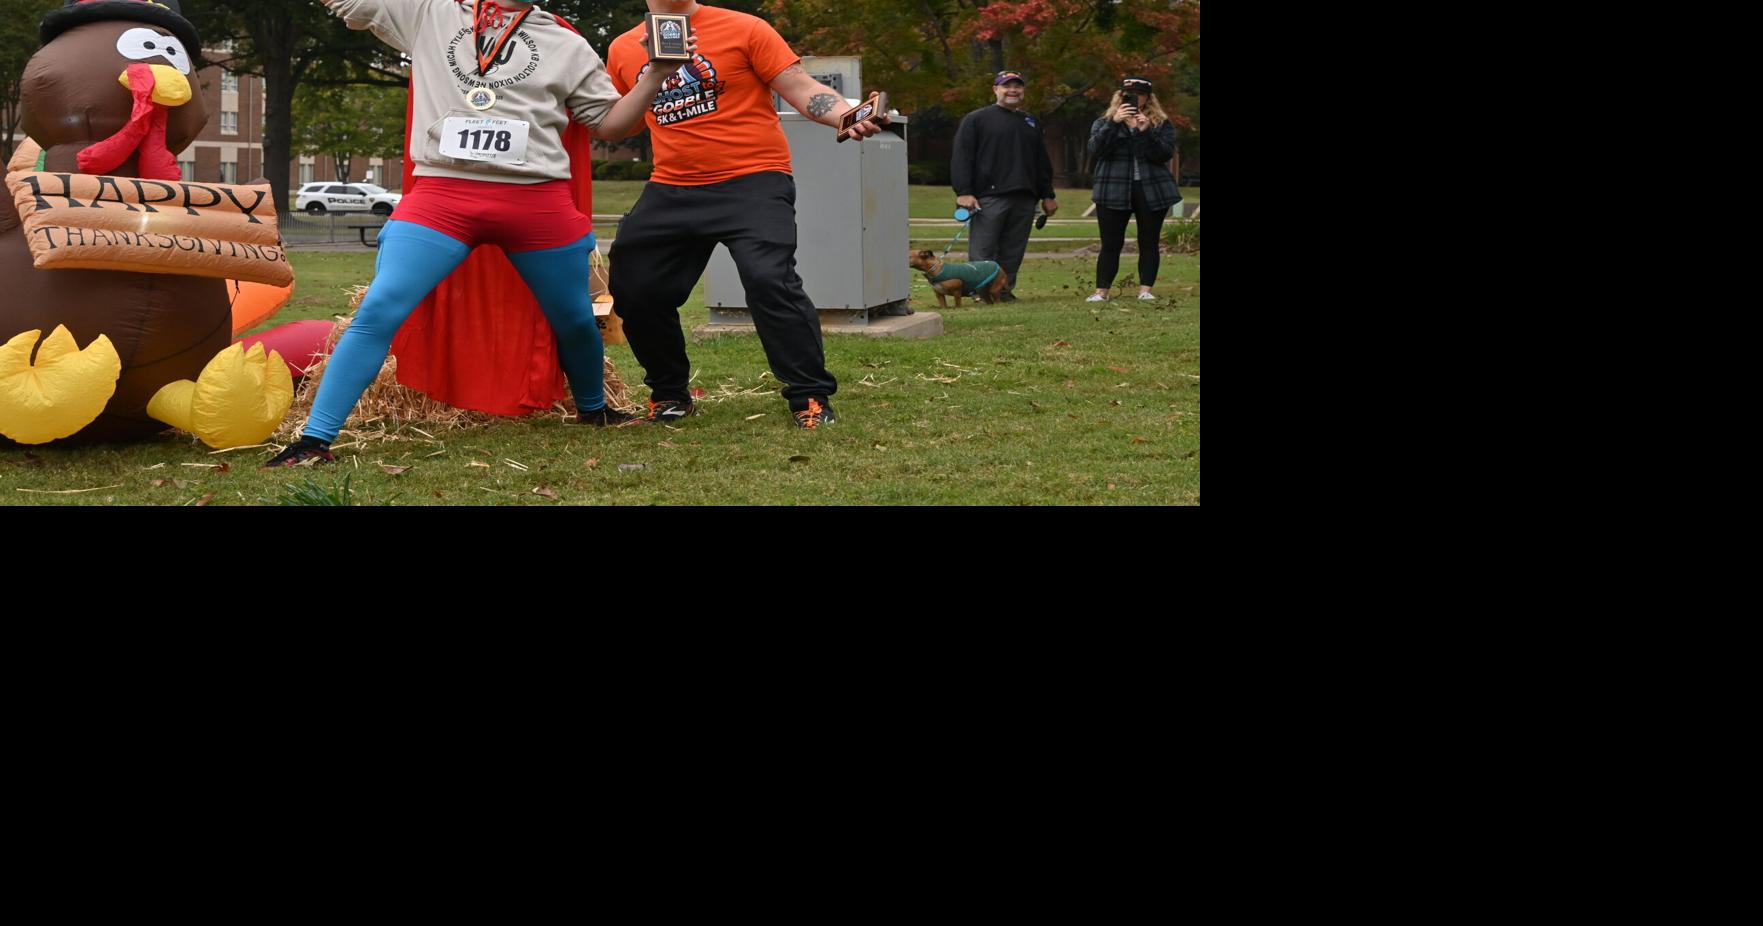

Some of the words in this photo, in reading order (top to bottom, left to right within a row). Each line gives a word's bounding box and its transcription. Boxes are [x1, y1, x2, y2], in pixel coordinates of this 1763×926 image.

[447, 45, 457, 67] MICAH
[452, 67, 487, 88] NEWSONG
[512, 61, 537, 82] COLTON
[489, 77, 513, 89] DIXON
[653, 90, 716, 114] GOBBLE
[657, 115, 669, 125] 5K
[669, 112, 677, 122] &
[677, 101, 715, 119] 1-MILE
[458, 129, 511, 152] 1178
[21, 174, 266, 224] HAPPY
[327, 197, 366, 205] POLICE
